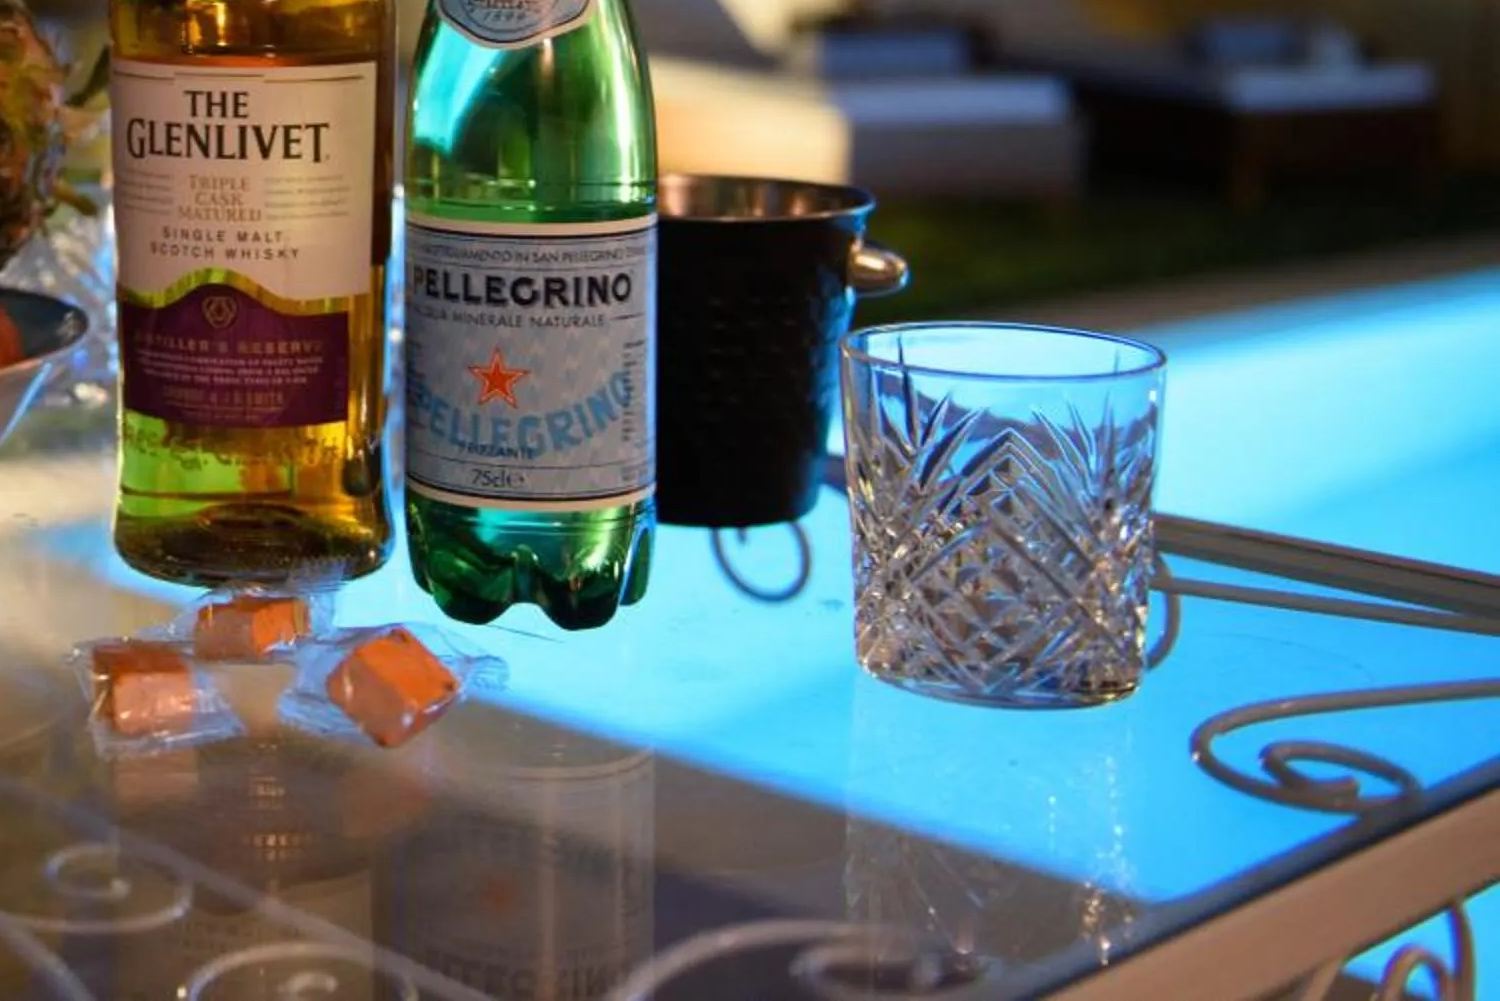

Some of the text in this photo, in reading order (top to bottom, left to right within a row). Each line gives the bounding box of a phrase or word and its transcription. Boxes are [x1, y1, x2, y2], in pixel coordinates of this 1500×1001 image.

[184, 90, 250, 118] THE
[126, 118, 329, 163] GLENLIVET
[189, 174, 249, 191] TRIPLE
[194, 192, 244, 206] CASK
[177, 205, 262, 222] MATURED
[162, 226, 282, 243] SINGLE MALT
[150, 241, 299, 261] SCOTCH WHISKY
[413, 265, 632, 309] PELLEGRINO
[452, 310, 523, 328] MINERALE
[530, 313, 606, 328] NATURALE
